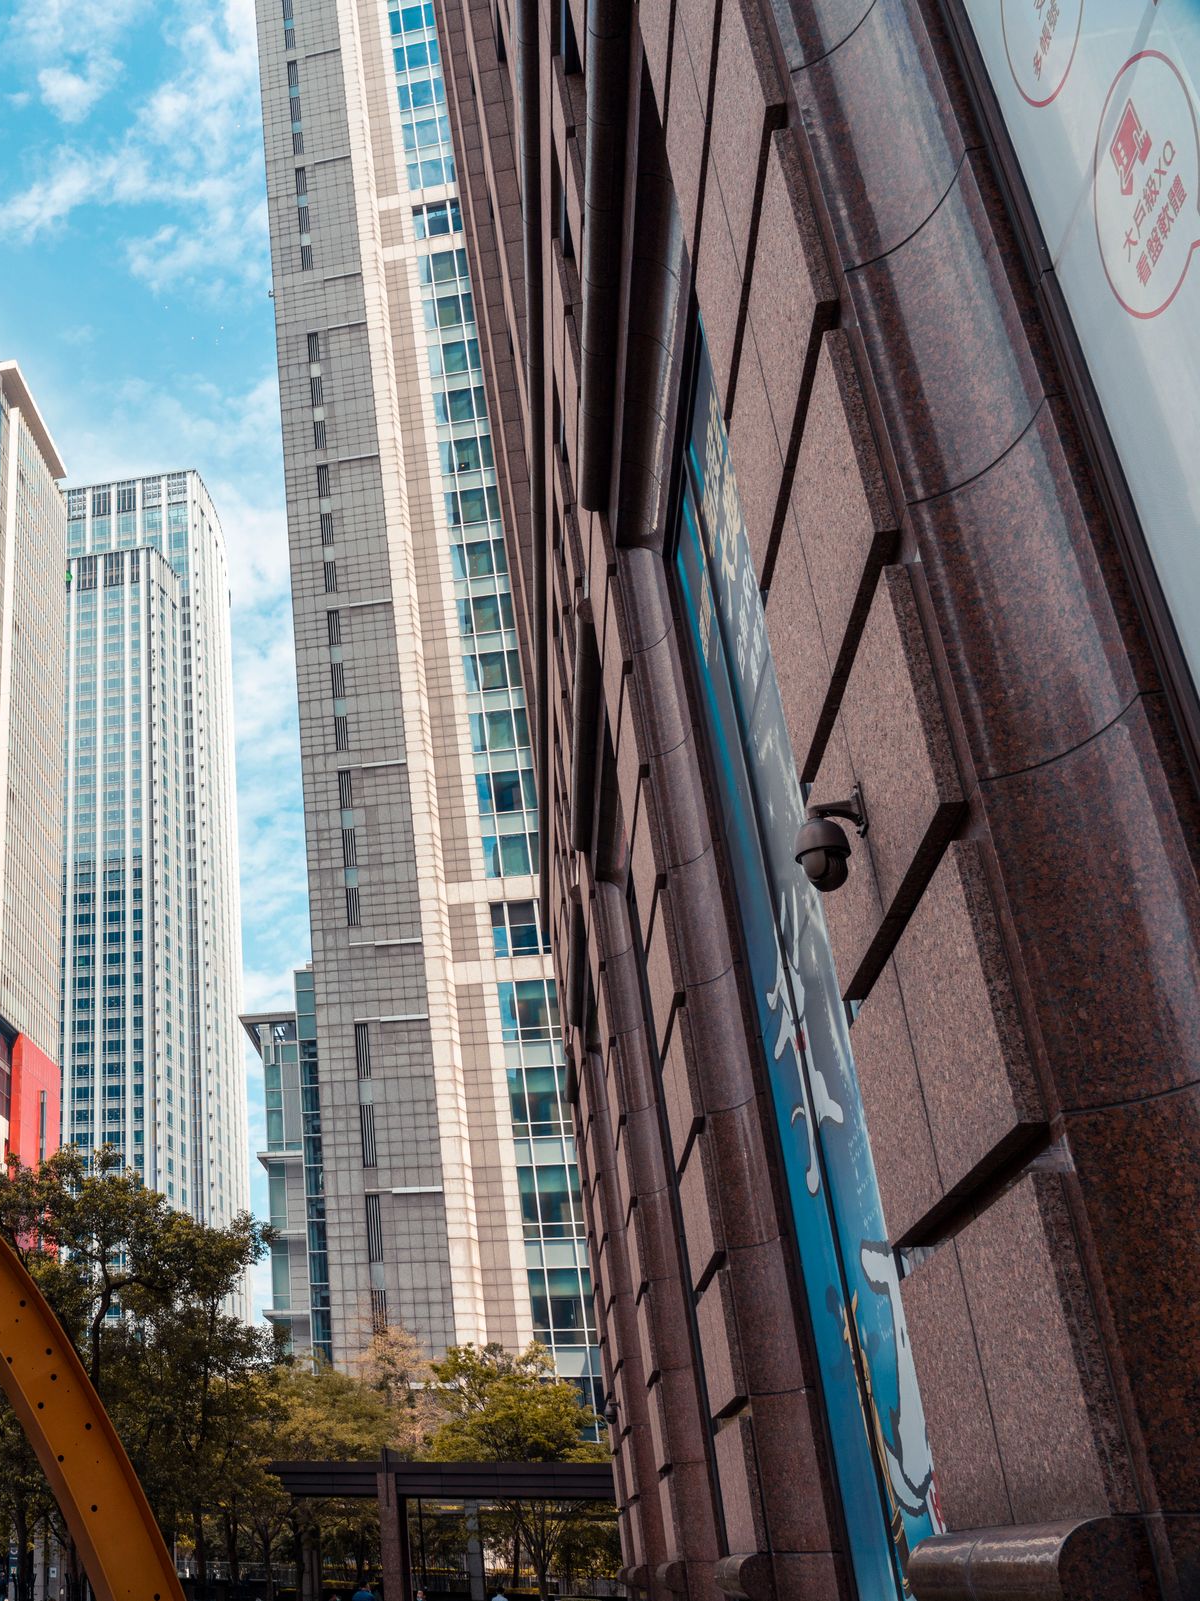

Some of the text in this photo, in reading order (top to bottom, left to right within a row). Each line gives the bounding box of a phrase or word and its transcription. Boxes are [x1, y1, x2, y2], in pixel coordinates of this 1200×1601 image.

[1123, 140, 1176, 263] 大戶級XQ
[1136, 174, 1188, 287] 看盤軟體
